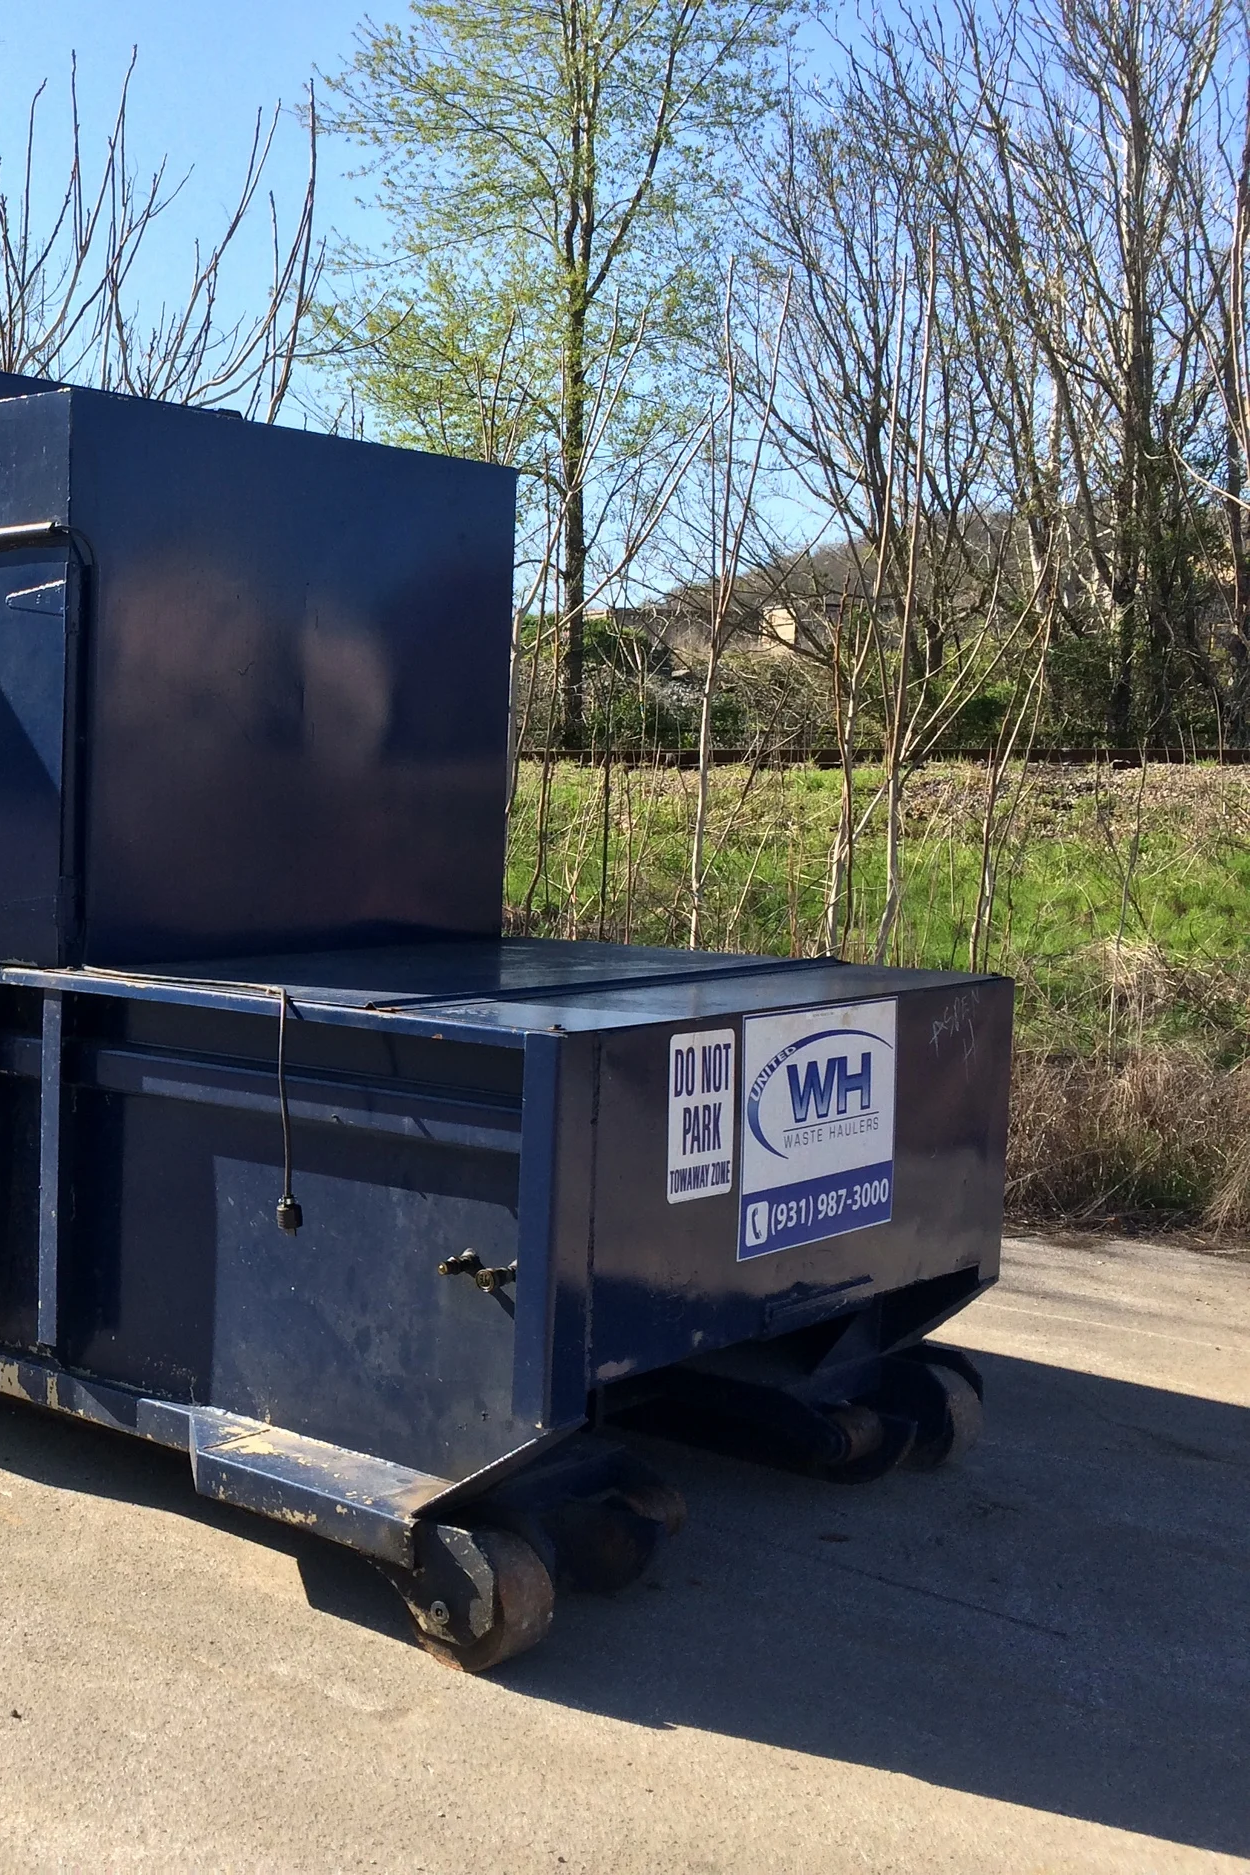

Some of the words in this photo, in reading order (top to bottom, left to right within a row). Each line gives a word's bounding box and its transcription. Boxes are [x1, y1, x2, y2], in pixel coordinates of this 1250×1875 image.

[674, 1047, 696, 1098] DO
[701, 1042, 731, 1093] NOT
[749, 1045, 798, 1102] UNITED
[786, 1051, 872, 1124] WH
[682, 1102, 722, 1156] PARK
[783, 1130, 823, 1149] WASTE
[829, 1116, 880, 1140] HAULERS
[670, 1162, 710, 1195] TOWAWAY
[711, 1160, 731, 1186] ZONE
[771, 1195, 814, 1236] (931)
[817, 1177, 890, 1220] 987-3000
